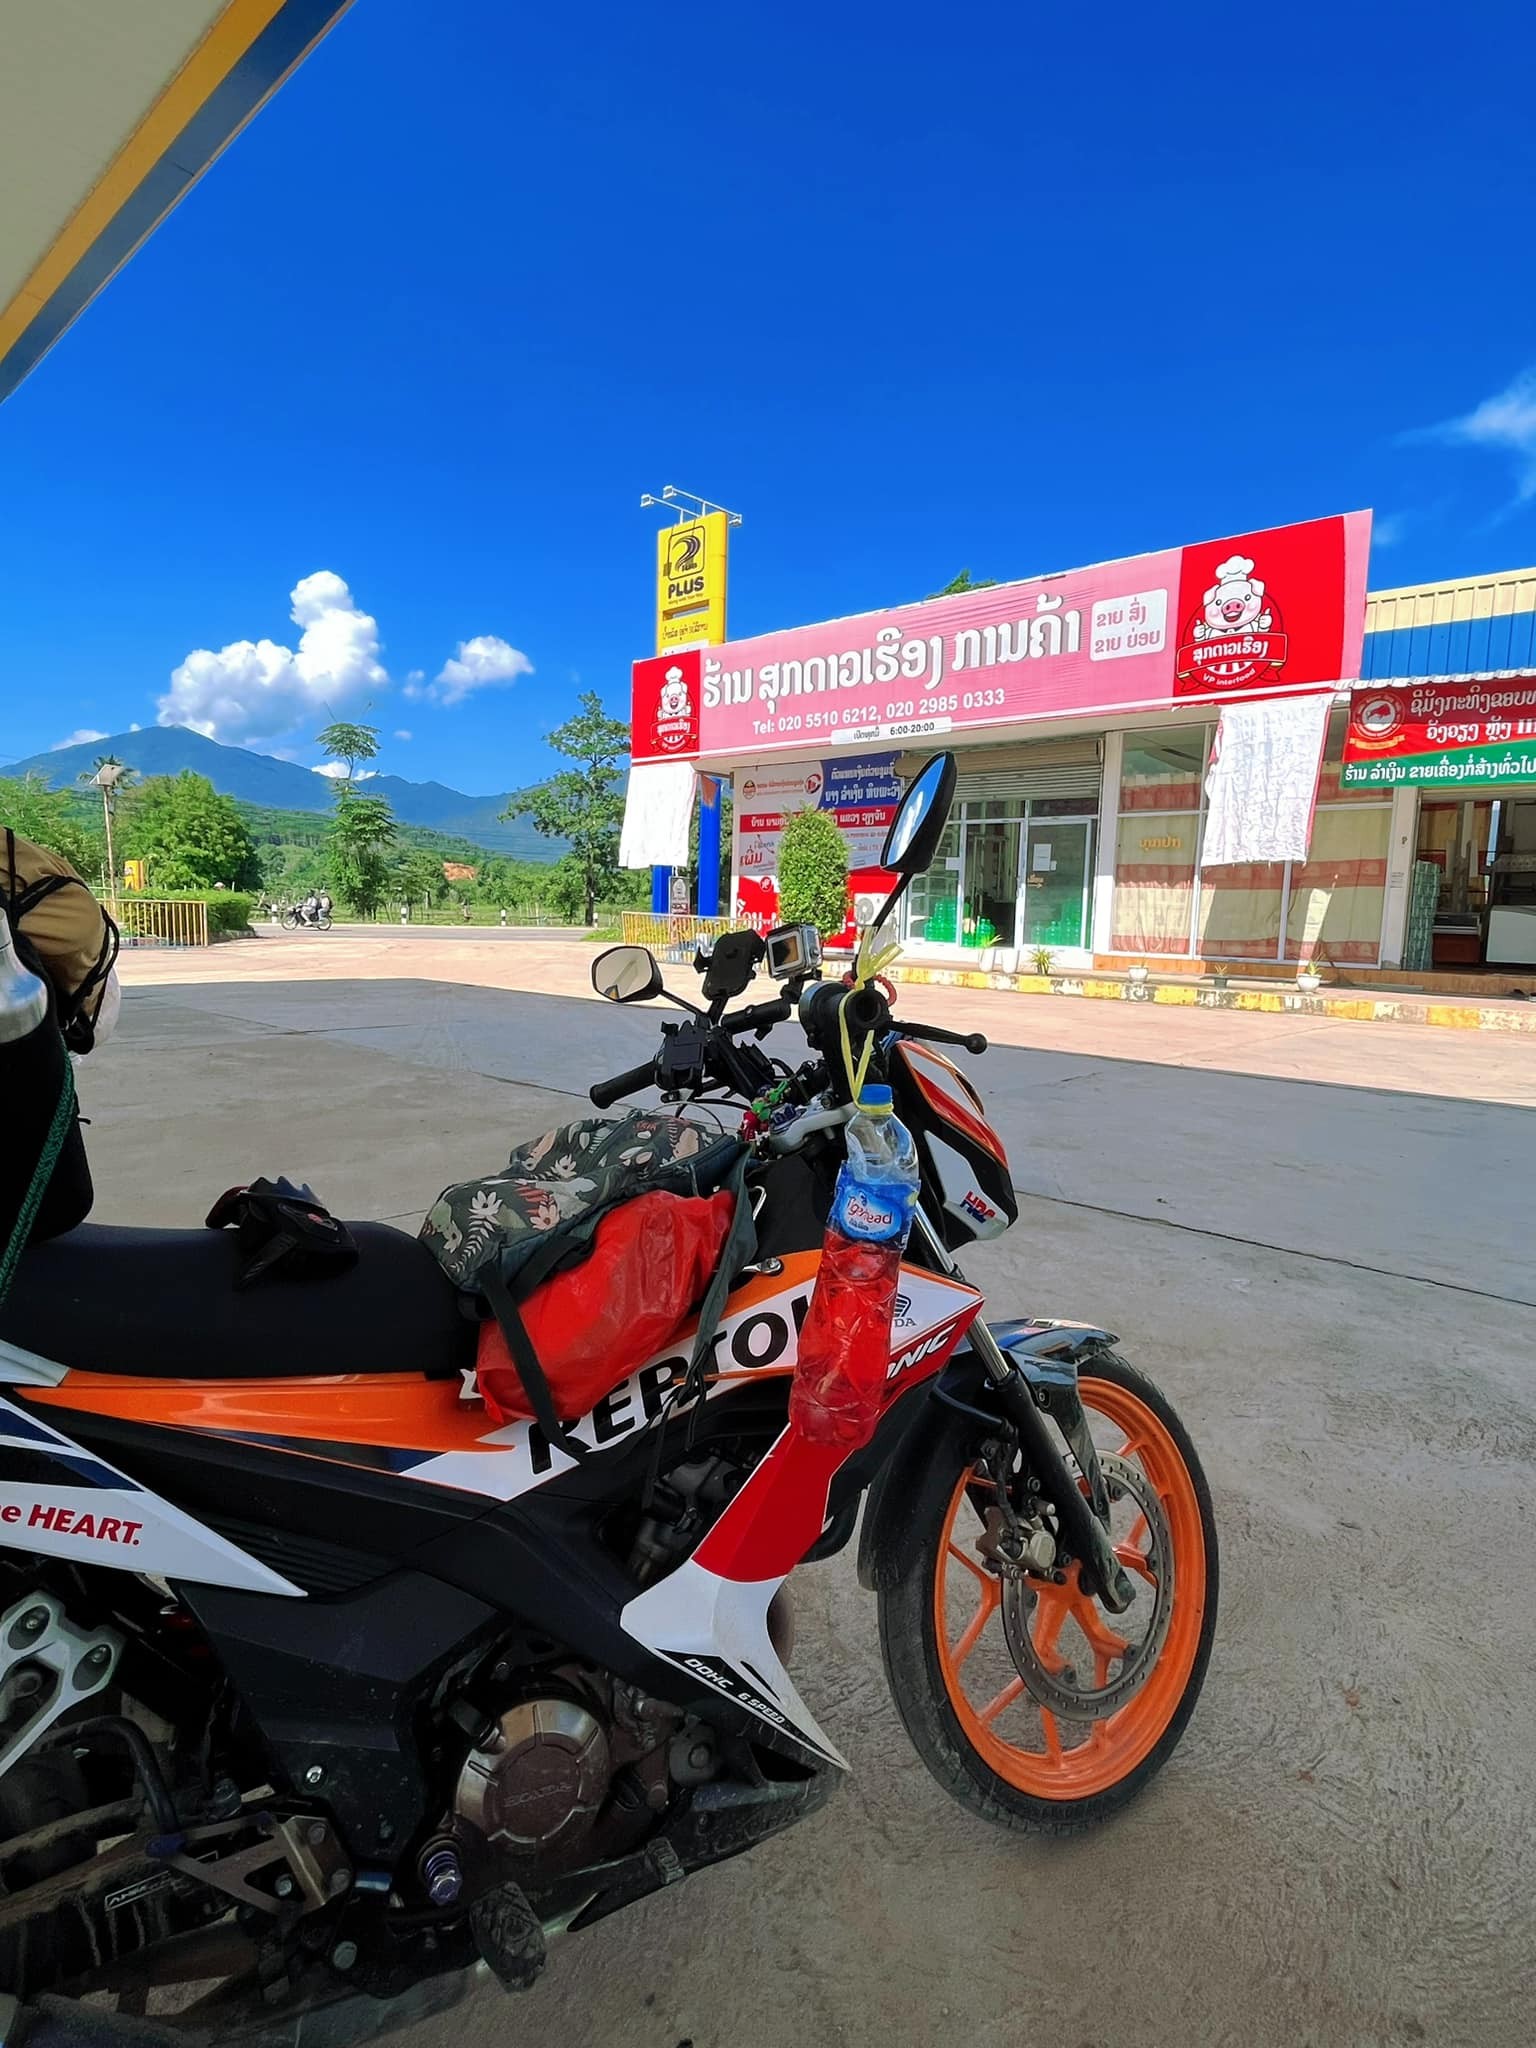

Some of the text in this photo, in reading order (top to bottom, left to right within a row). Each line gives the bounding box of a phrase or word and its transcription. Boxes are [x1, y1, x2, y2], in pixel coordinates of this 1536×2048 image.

[668, 576, 704, 599] PLUS
[1096, 608, 1123, 628] ຂາຍ
[703, 658, 752, 707] ຮ້ານ
[952, 593, 1079, 671] ການຄ້າ
[1095, 628, 1161, 654] ຂາຍ ຍ່ອຍ
[1203, 673, 1216, 684] VP
[753, 688, 1005, 735] Tel: 020 5510 6212, 020 2985 0333
[889, 721, 935, 738] 6:00-20:00
[1345, 763, 1367, 780] ຮ້ານ
[27, 1504, 143, 1545] HEART.
[684, 1658, 735, 1689] DOHC
[747, 1698, 786, 1724] SPEED
